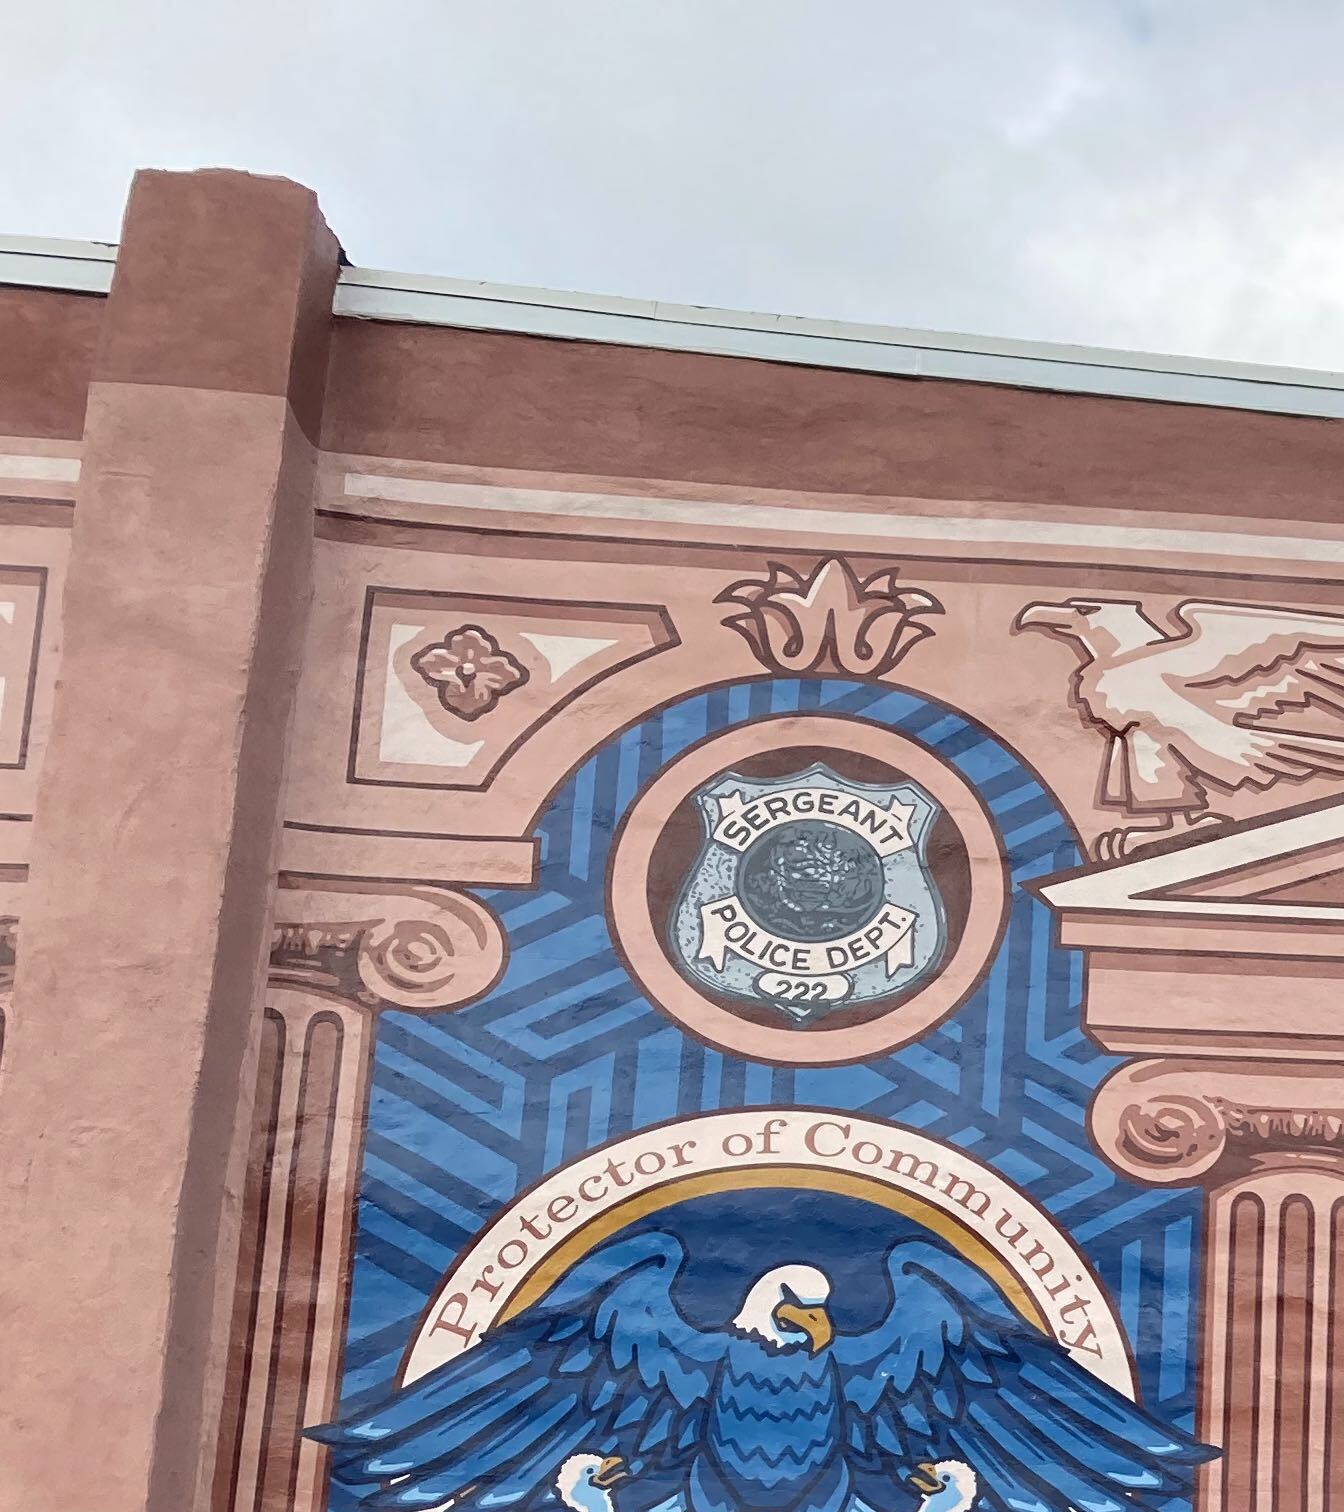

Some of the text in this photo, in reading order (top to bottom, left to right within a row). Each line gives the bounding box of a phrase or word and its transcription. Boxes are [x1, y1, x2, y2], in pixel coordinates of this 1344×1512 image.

[723, 791, 904, 846] SERGEANT
[711, 903, 908, 972] POLICE DEPT.
[775, 978, 829, 1000] 222
[430, 1119, 1105, 1363] Protector of Community
